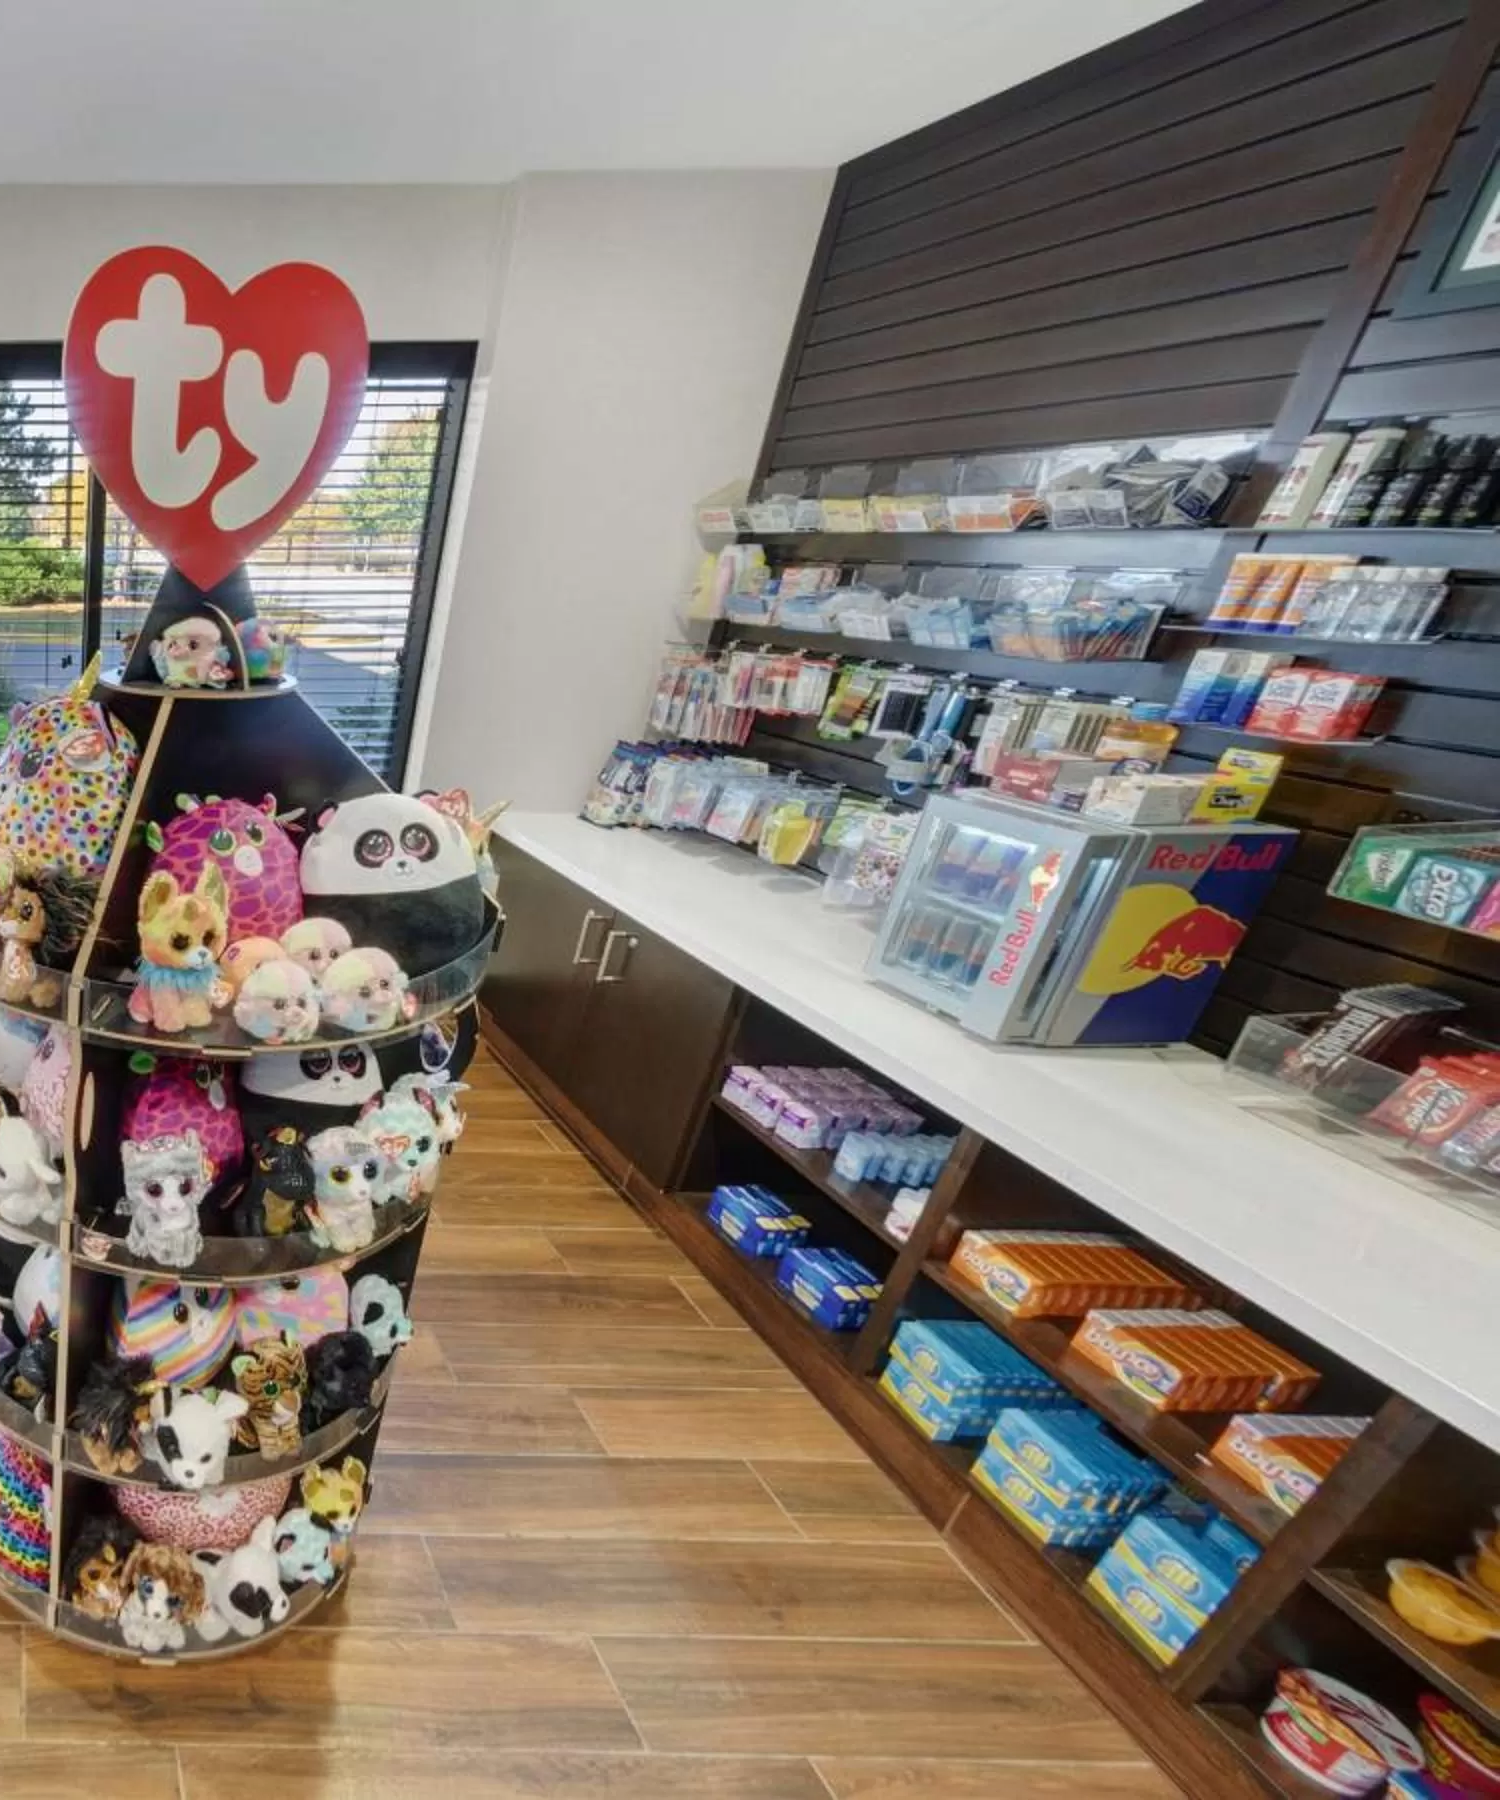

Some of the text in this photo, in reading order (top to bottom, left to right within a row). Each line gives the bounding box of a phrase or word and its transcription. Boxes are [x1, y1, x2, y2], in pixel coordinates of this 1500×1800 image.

[95, 272, 330, 531] ty
[1148, 843, 1281, 871] Red Bull
[988, 909, 1035, 986] Red Bull
